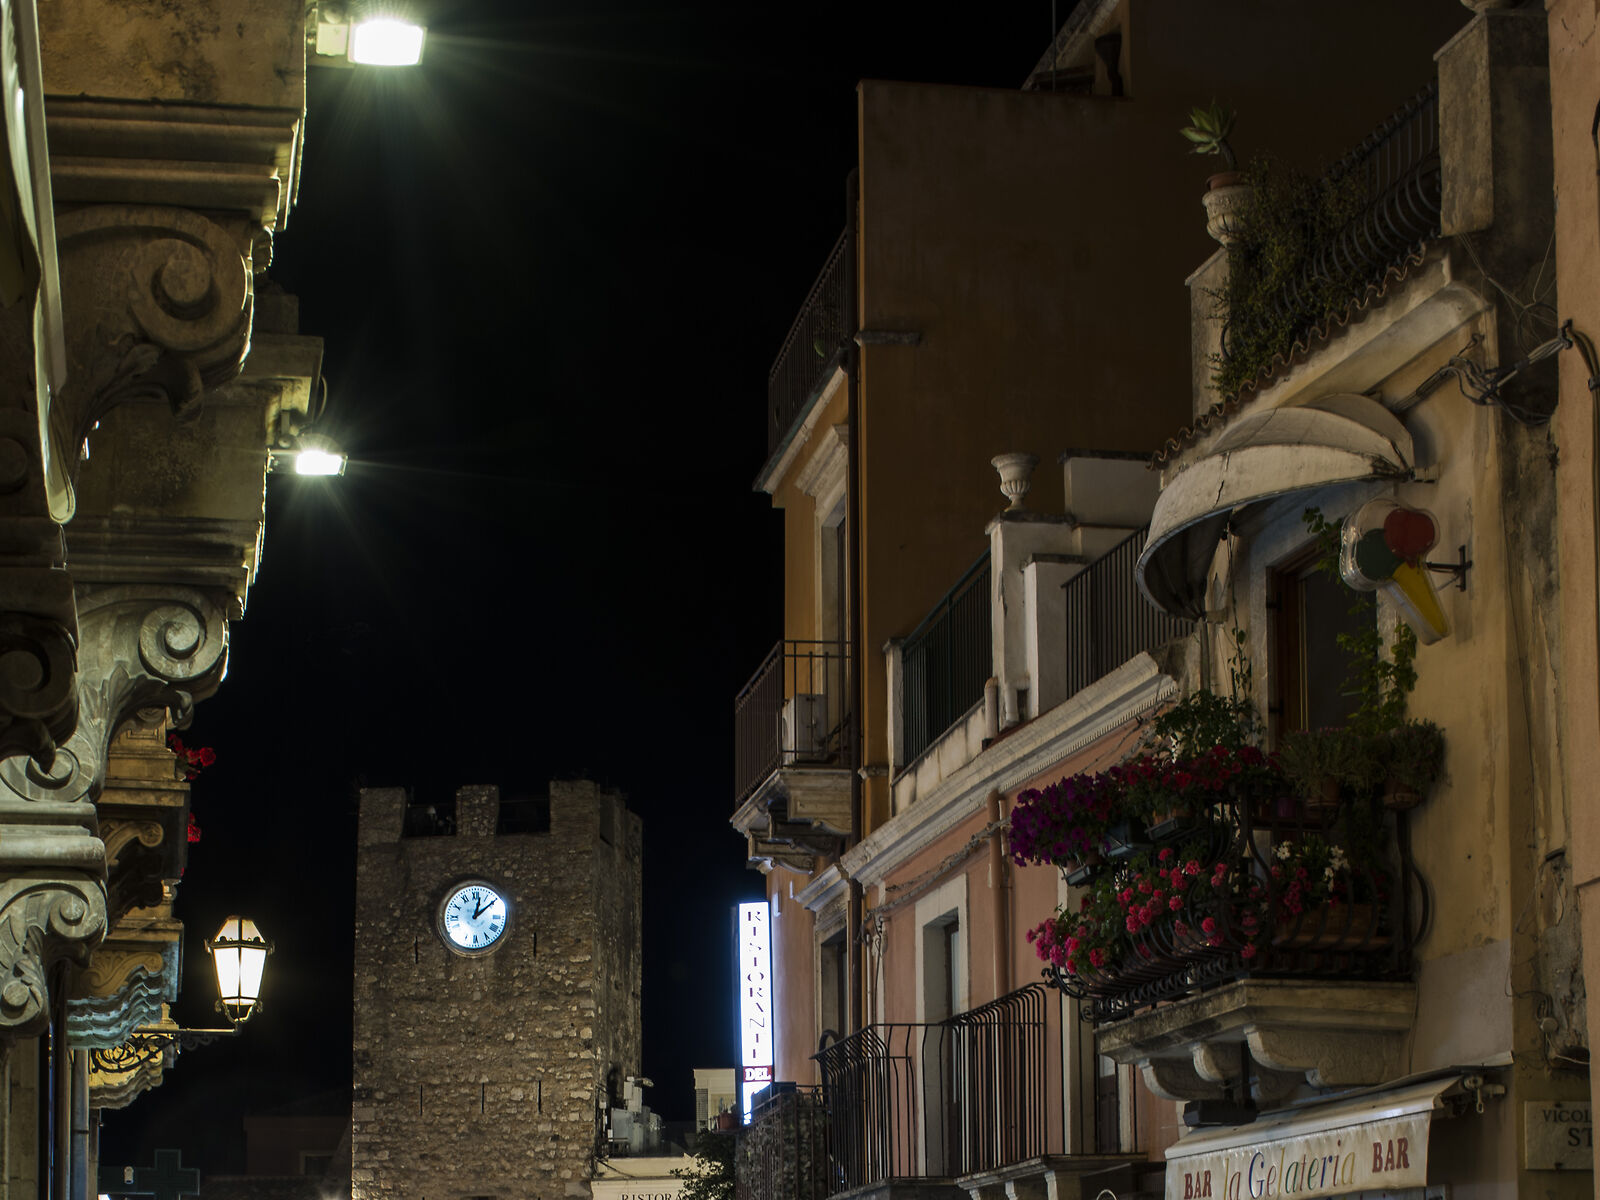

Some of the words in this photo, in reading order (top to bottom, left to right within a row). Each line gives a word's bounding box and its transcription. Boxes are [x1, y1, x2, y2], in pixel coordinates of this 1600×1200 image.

[744, 1067, 772, 1081] DEL
[1542, 1109, 1592, 1123] VICOL
[1567, 1127, 1593, 1147] ST
[1184, 1169, 1213, 1200] BAR
[1248, 1139, 1356, 1200] Gelateria
[1371, 1137, 1410, 1173] BAR
